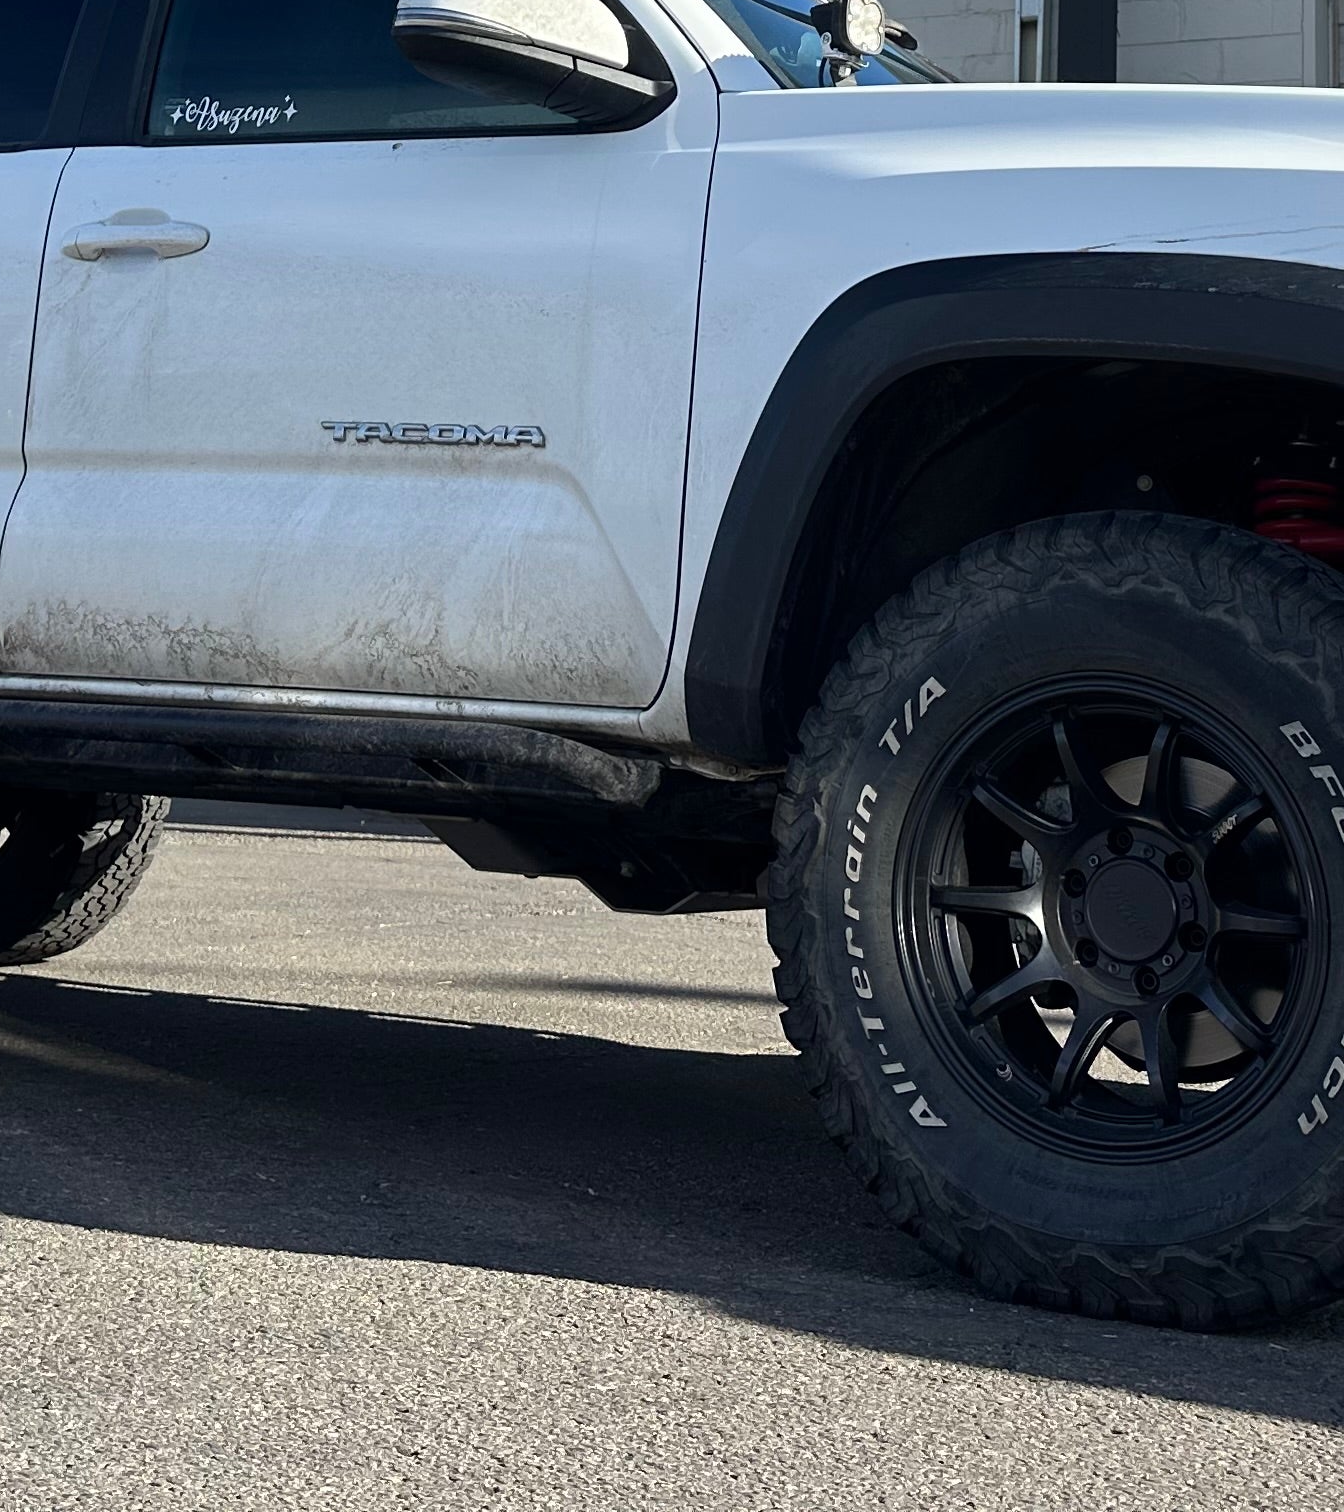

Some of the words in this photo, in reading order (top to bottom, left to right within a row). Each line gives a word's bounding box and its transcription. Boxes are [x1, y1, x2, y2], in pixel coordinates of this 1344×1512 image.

[321, 421, 546, 447] TACOMA
[877, 675, 948, 757] T/A
[844, 784, 948, 1130] All-Terrain
